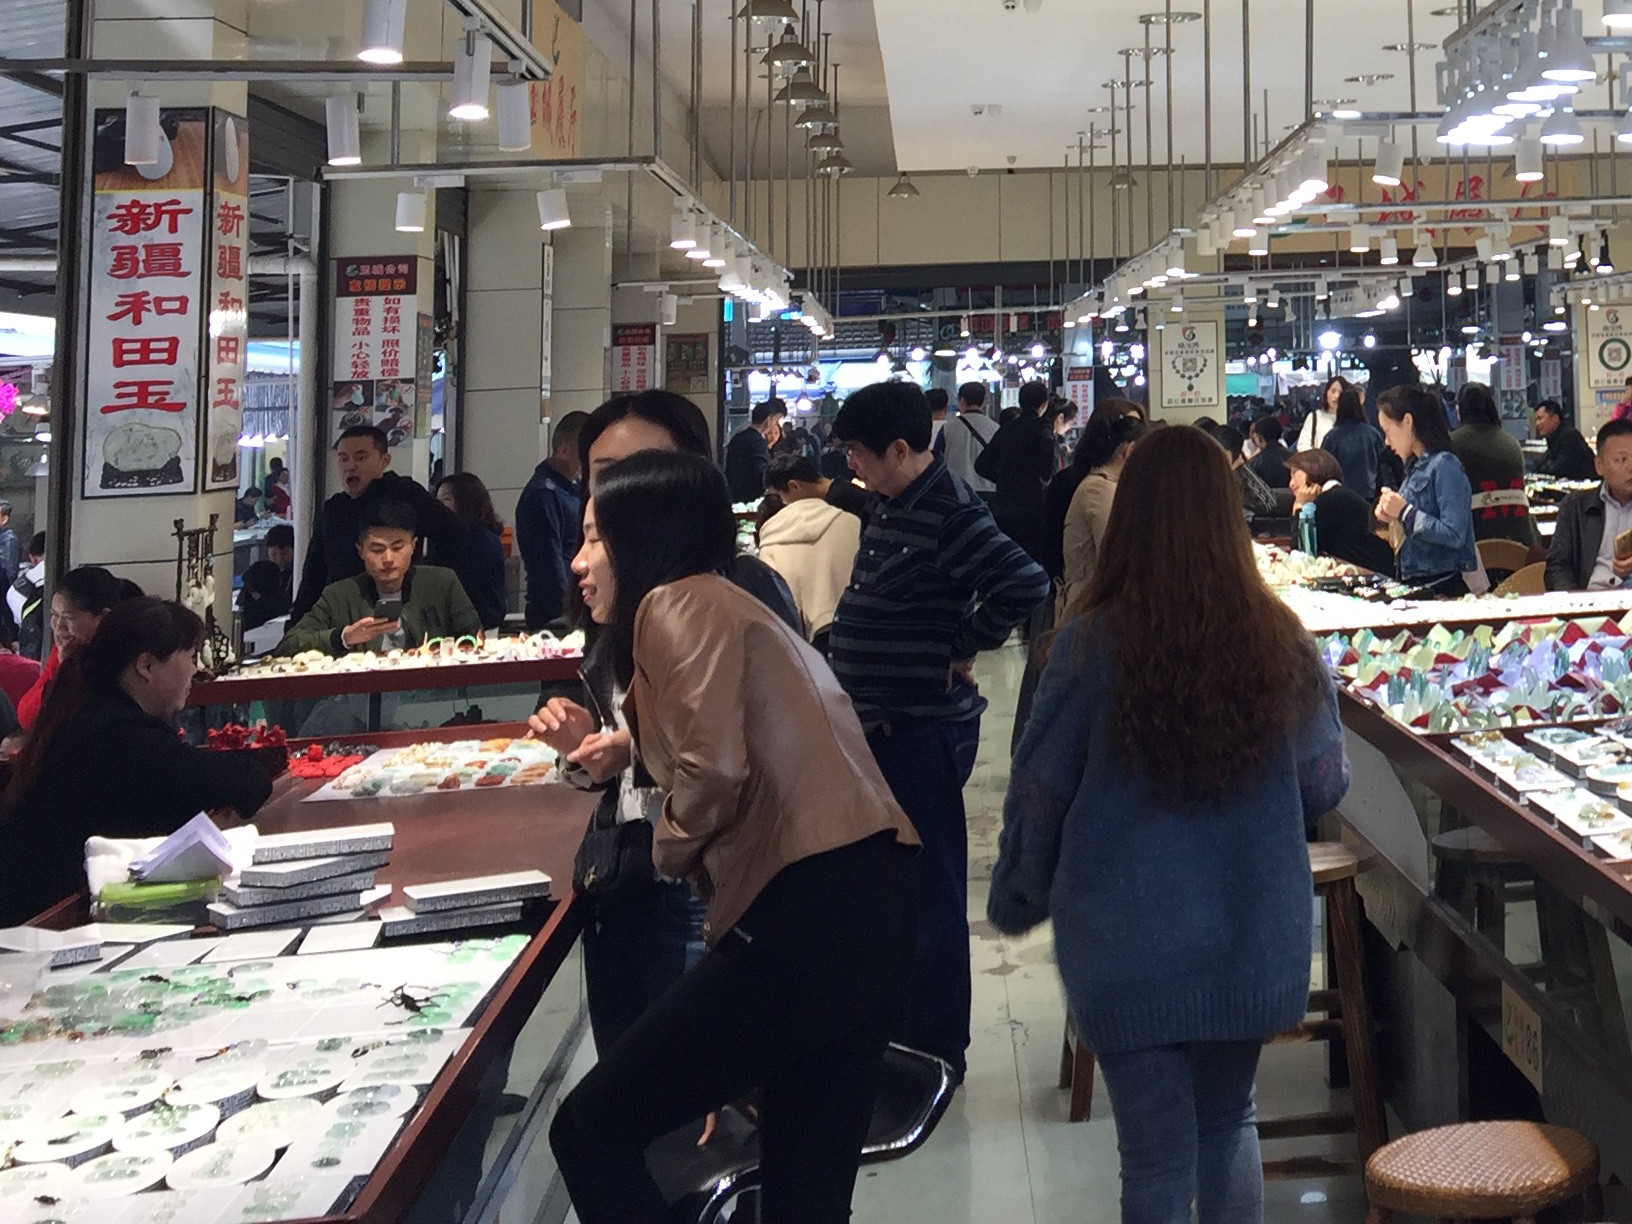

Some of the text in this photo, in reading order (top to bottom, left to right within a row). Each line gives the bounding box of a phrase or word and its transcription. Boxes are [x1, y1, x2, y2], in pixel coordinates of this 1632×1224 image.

[99, 198, 194, 415] 新疆和田玉
[381, 297, 401, 335] 如有损坏
[350, 340, 371, 380] 小心轻放
